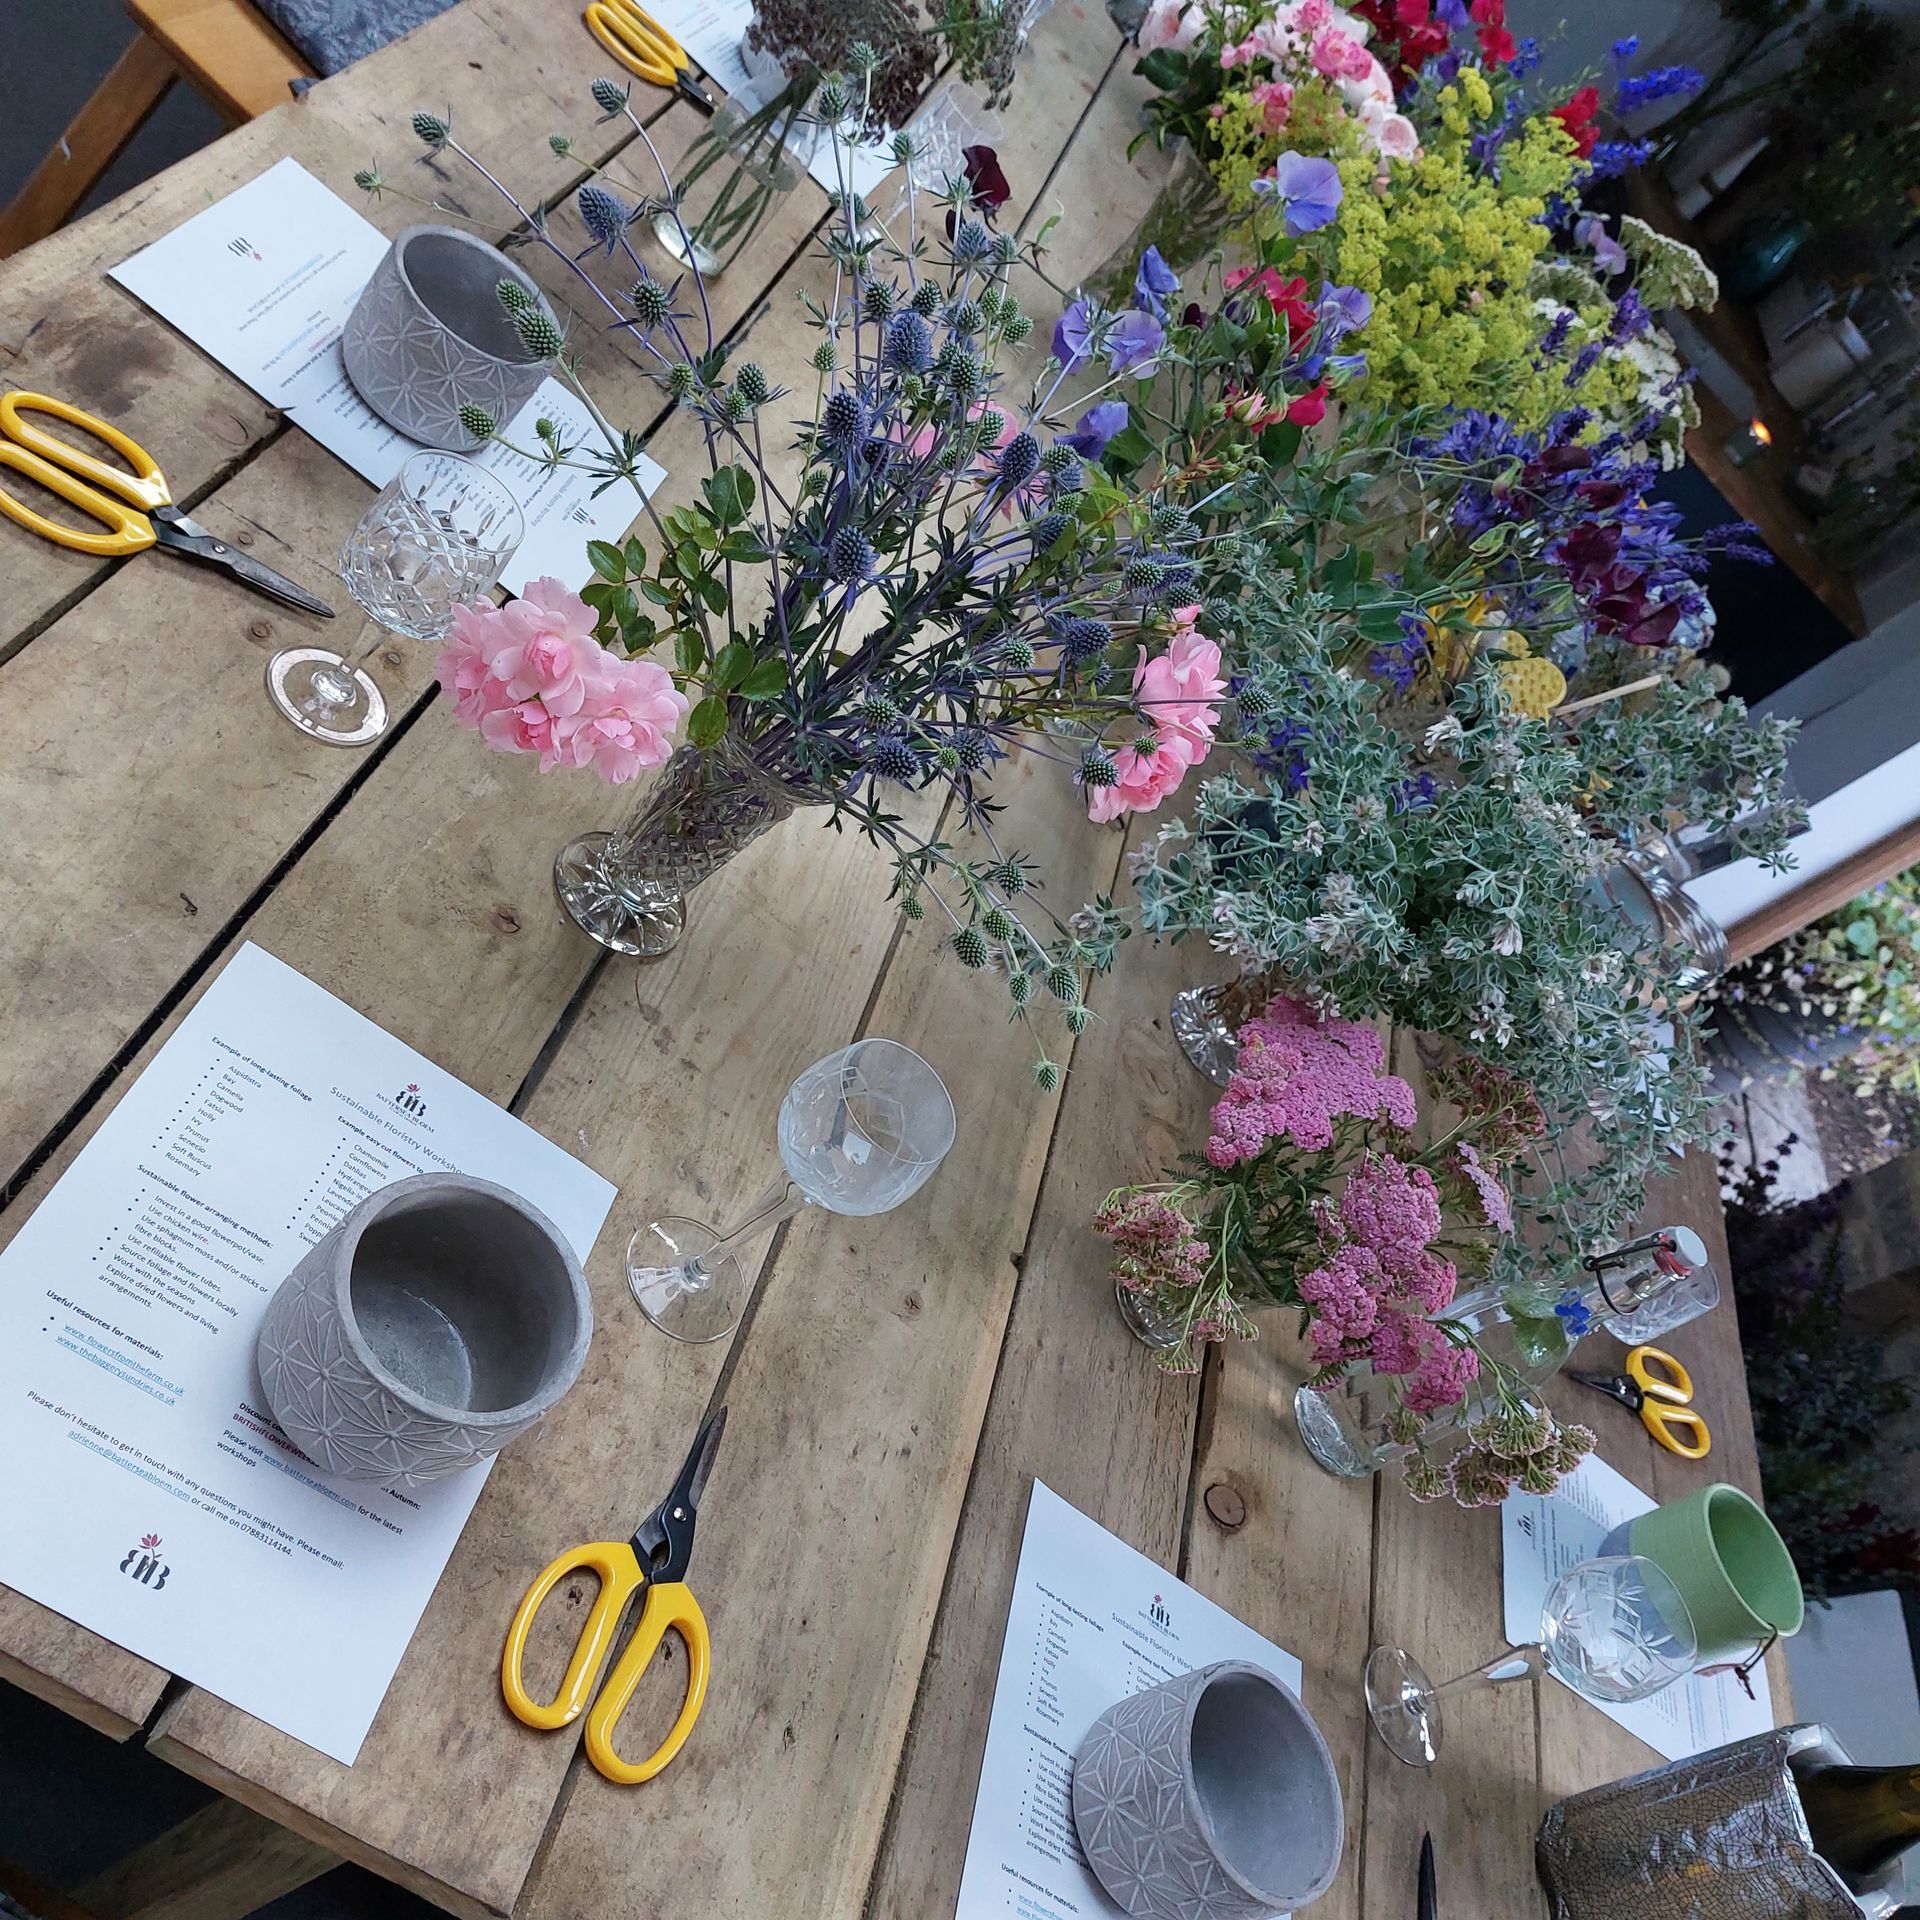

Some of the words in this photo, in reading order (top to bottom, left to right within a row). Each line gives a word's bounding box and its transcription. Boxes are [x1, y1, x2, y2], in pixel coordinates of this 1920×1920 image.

[212, 1037, 241, 1057] Example
[251, 1061, 289, 1088] long-lasting
[290, 1085, 312, 1101] foliage
[223, 1074, 236, 1084] Bay
[229, 1066, 261, 1088] Aspidistra
[204, 1099, 224, 1114] Fatsia
[210, 1090, 244, 1112] Dogwood
[191, 1116, 203, 1126] Ivy
[198, 1108, 216, 1122] Holly
[178, 1134, 206, 1153] Senecio
[185, 1125, 210, 1143] Prunus
[330, 1087, 382, 1125] Sustainable
[384, 1122, 421, 1150] Floristry
[422, 1145, 467, 1179] Worksho
[171, 1143, 187, 1155] Soft
[187, 1152, 212, 1170] Ruscus
[338, 1116, 365, 1136] Example
[366, 1135, 381, 1146] easy
[381, 1145, 392, 1154] cut
[392, 1151, 416, 1169] flowers
[416, 1167, 424, 1175] to
[354, 1145, 389, 1169] Chamomile
[165, 1152, 200, 1176] Rosemary
[344, 1161, 366, 1179] Dahlias
[349, 1153, 386, 1179] Cornflowers
[138, 1165, 179, 1192] Sustainable
[180, 1190, 204, 1207] flower
[205, 1206, 239, 1229] arranging
[240, 1227, 273, 1248] methods:
[155, 1195, 177, 1212] Invest
[191, 1219, 212, 1231] good
[321, 1196, 348, 1215] Leucant
[149, 1205, 163, 1217] Use
[163, 1215, 191, 1233] chicken
[192, 1231, 208, 1245] wire.
[304, 1223, 325, 1239] Poppi
[310, 1214, 333, 1231] Pennis
[135, 1224, 152, 1237] fibre
[153, 1235, 177, 1253] blocks.
[298, 1232, 318, 1247] Swee
[128, 1234, 142, 1246] Use
[143, 1244, 175, 1265] refillable
[176, 1262, 200, 1279] flower
[201, 1277, 221, 1293] tubes.
[142, 1215, 156, 1226] Use
[157, 1225, 194, 1248] sphagnum
[195, 1247, 214, 1260] moss
[214, 1259, 240, 1275] and/or
[239, 1274, 259, 1288] sticks
[99, 1275, 151, 1308] arrangements.
[114, 1254, 134, 1269] Work
[135, 1267, 152, 1280] with
[153, 1277, 166, 1288] the
[166, 1286, 195, 1305] seasons
[120, 1244, 146, 1262] Source
[147, 1259, 172, 1277] foliage
[172, 1275, 188, 1286] and
[188, 1283, 215, 1302] flowers
[215, 1299, 238, 1317] locally
[106, 1264, 134, 1284] Explore
[135, 1282, 156, 1296] dried
[156, 1293, 184, 1312] flowers
[184, 1310, 200, 1321] and
[200, 1318, 219, 1334] living
[47, 1290, 73, 1308] Useful
[73, 1306, 111, 1330] resources
[112, 1327, 124, 1336] for
[125, 1336, 163, 1360] materials:
[238, 1403, 273, 1427] Discount
[218, 1442, 256, 1467] workshops
[27, 1391, 54, 1409] Please
[77, 1418, 109, 1440] hesitate
[119, 1443, 134, 1454] get
[144, 1455, 166, 1471] touch
[167, 1469, 184, 1482] with
[185, 1479, 200, 1491] any
[200, 1488, 237, 1511] questions
[237, 1508, 252, 1519] you
[253, 1517, 275, 1532] might
[276, 1527, 294, 1543] have.
[297, 1539, 320, 1557] Please
[321, 1554, 344, 1570] email:
[224, 1430, 247, 1447] Please
[248, 1445, 263, 1457] visit
[358, 1505, 369, 1516] for
[370, 1513, 382, 1523] the
[383, 1519, 402, 1535] latest
[389, 1490, 420, 1510] Autumn:
[201, 1504, 216, 1514] call
[216, 1511, 228, 1521] me
[229, 1519, 240, 1528] on
[1112, 1613, 1148, 1642] Sustainable
[1150, 1638, 1175, 1661] Floristry
[1177, 1655, 1196, 1675] Work
[1036, 1707, 1059, 1727] Rosemary
[1002, 1863, 1018, 1877] Useful
